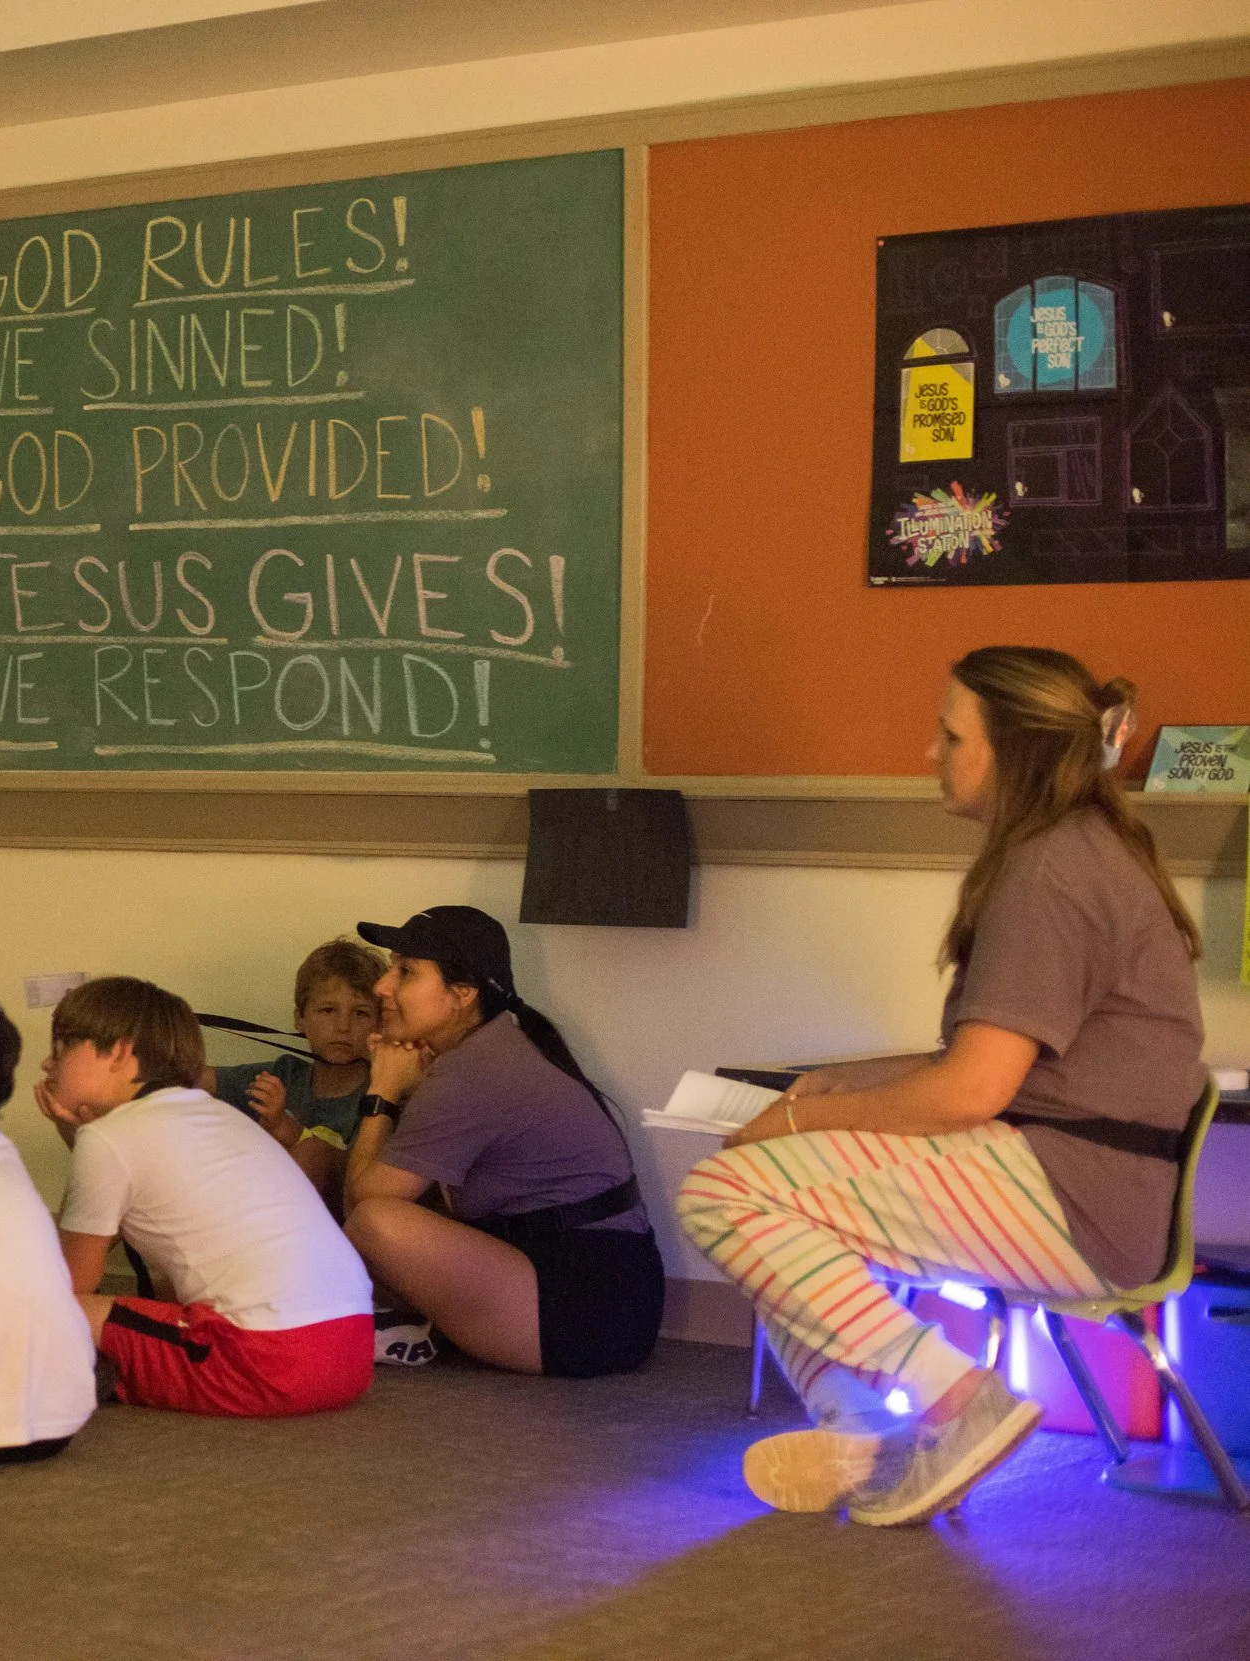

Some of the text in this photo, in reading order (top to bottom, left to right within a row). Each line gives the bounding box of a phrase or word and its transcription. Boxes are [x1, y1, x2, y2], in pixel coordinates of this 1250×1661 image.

[139, 196, 408, 304] RULES!
[80, 303, 347, 401] SINNED!
[130, 407, 492, 514] PROVIDED!
[249, 547, 567, 662] GIVES!
[93, 644, 493, 750] RESPOND!
